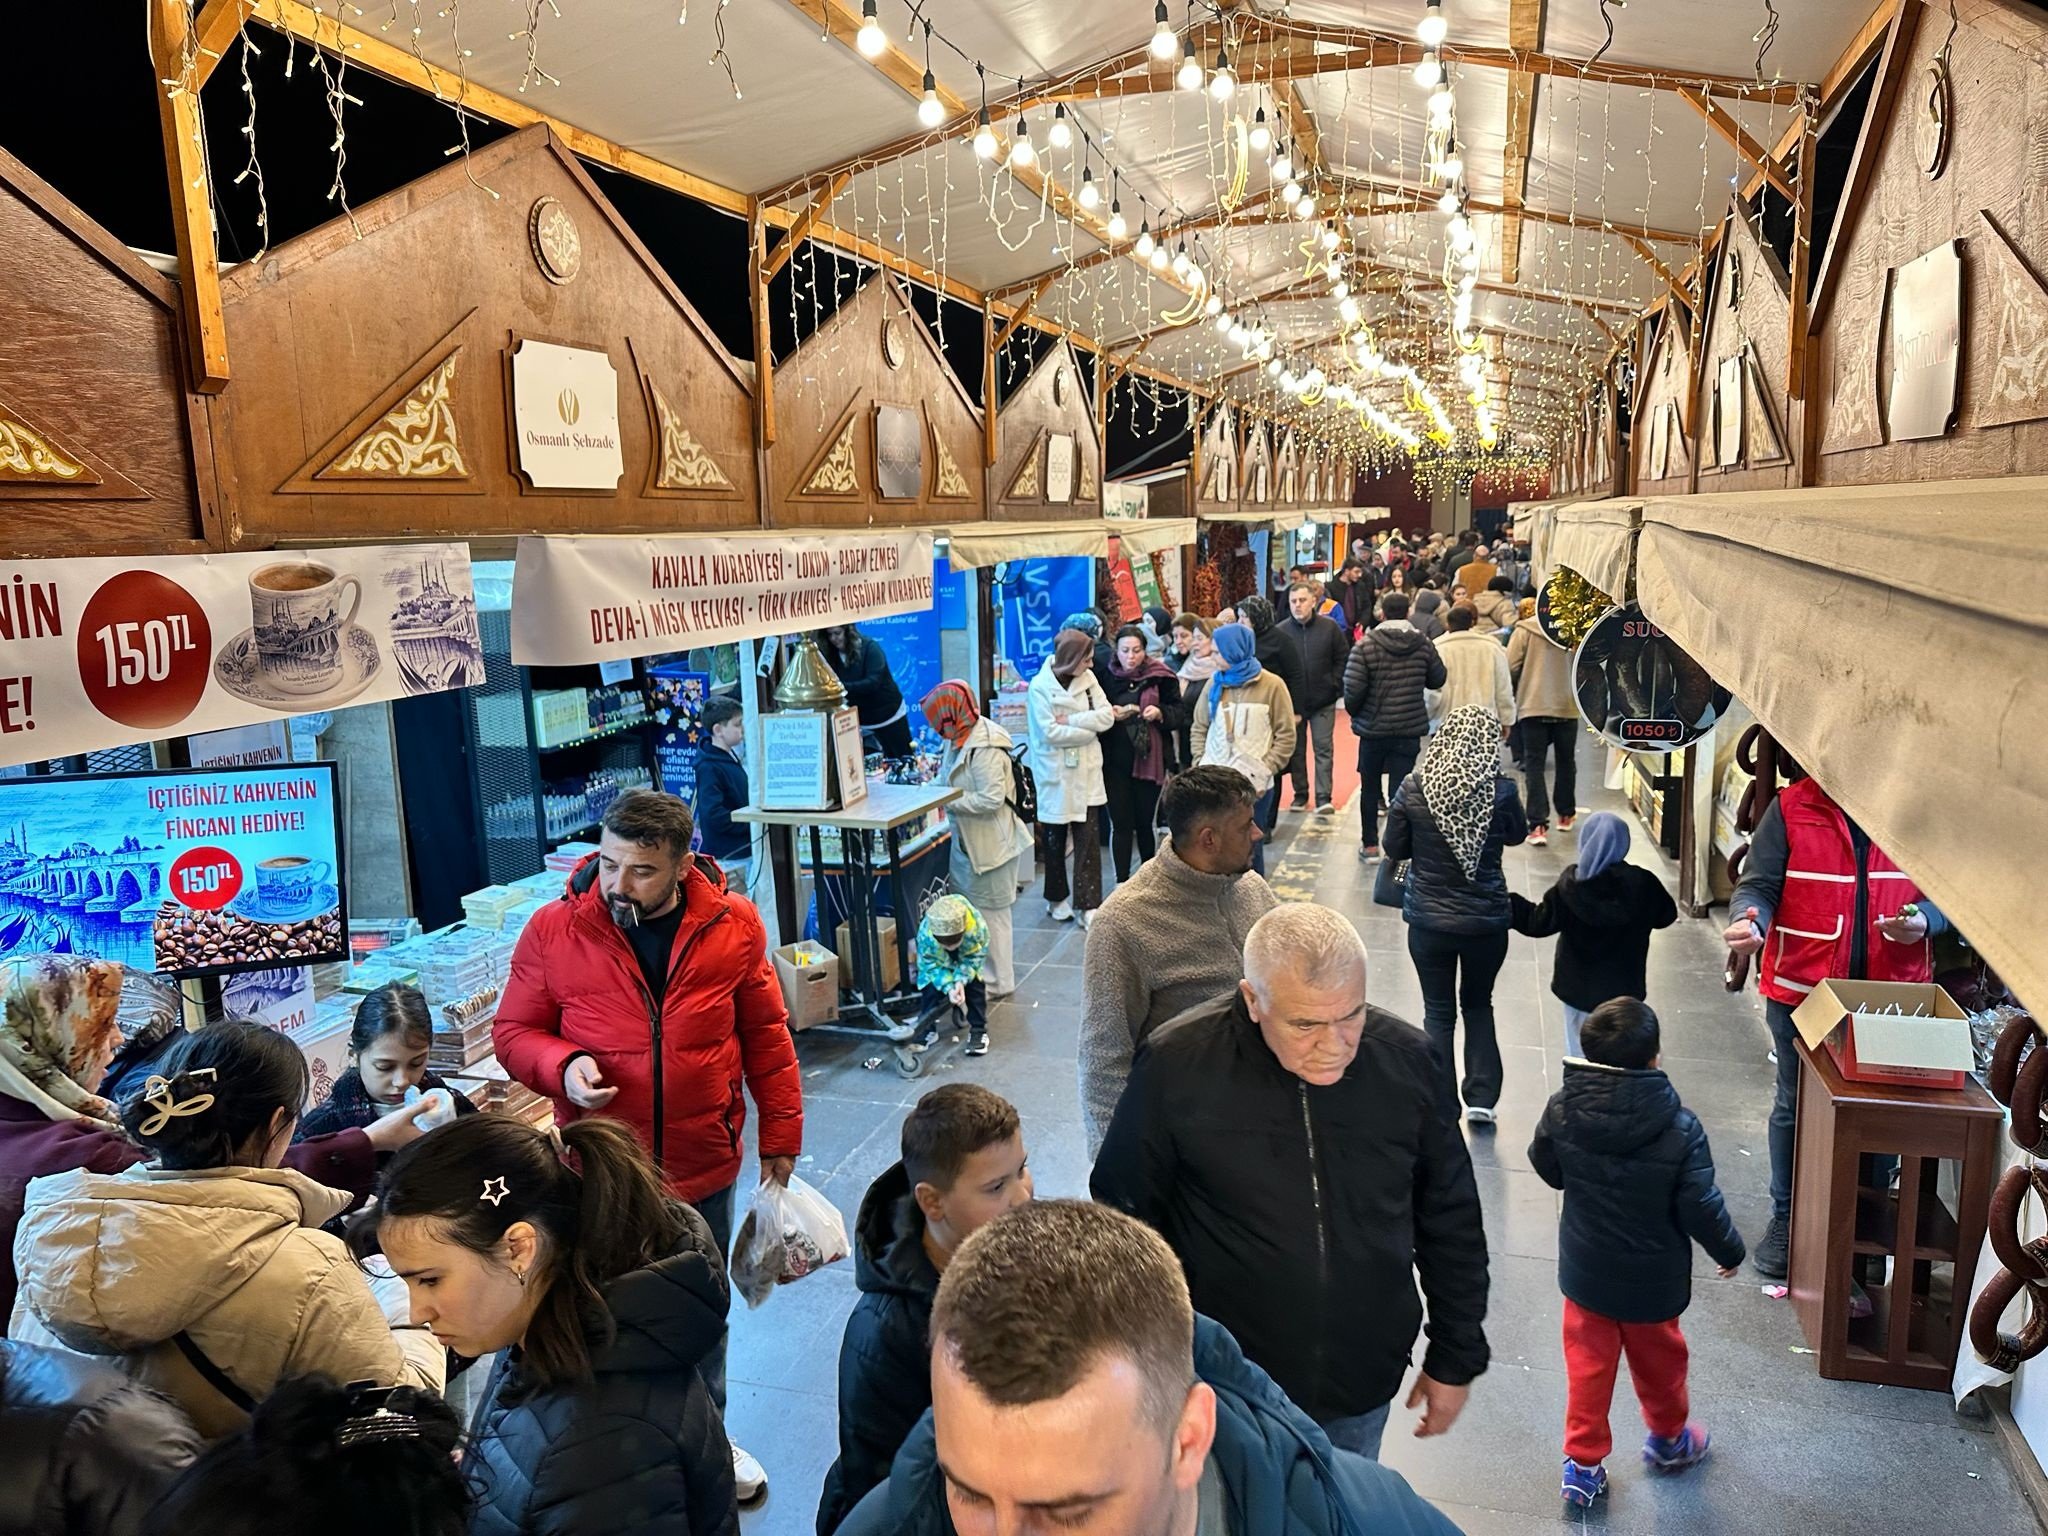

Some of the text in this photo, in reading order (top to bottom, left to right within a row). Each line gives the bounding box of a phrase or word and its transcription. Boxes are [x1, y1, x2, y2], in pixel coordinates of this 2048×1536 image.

[527, 430, 615, 451] Osmanlı Şehzade
[652, 542, 899, 589] KAVALA KURABİYESİ LOKUM BADEM EZMESİ
[591, 600, 649, 644] DEVA-İ
[650, 598, 690, 637] MİSK
[691, 596, 745, 631] HELVASI
[758, 589, 787, 622] TÜRK
[790, 583, 832, 616] KAHVESİ
[840, 579, 886, 614] HOŞGÜVAR
[1626, 724, 1665, 737] 1050
[243, 745, 282, 767] KAHVENİN
[148, 777, 317, 812] İÇTİĞİNİZ KAHVENİN
[166, 810, 305, 840] FİNCANI HEDİYE!
